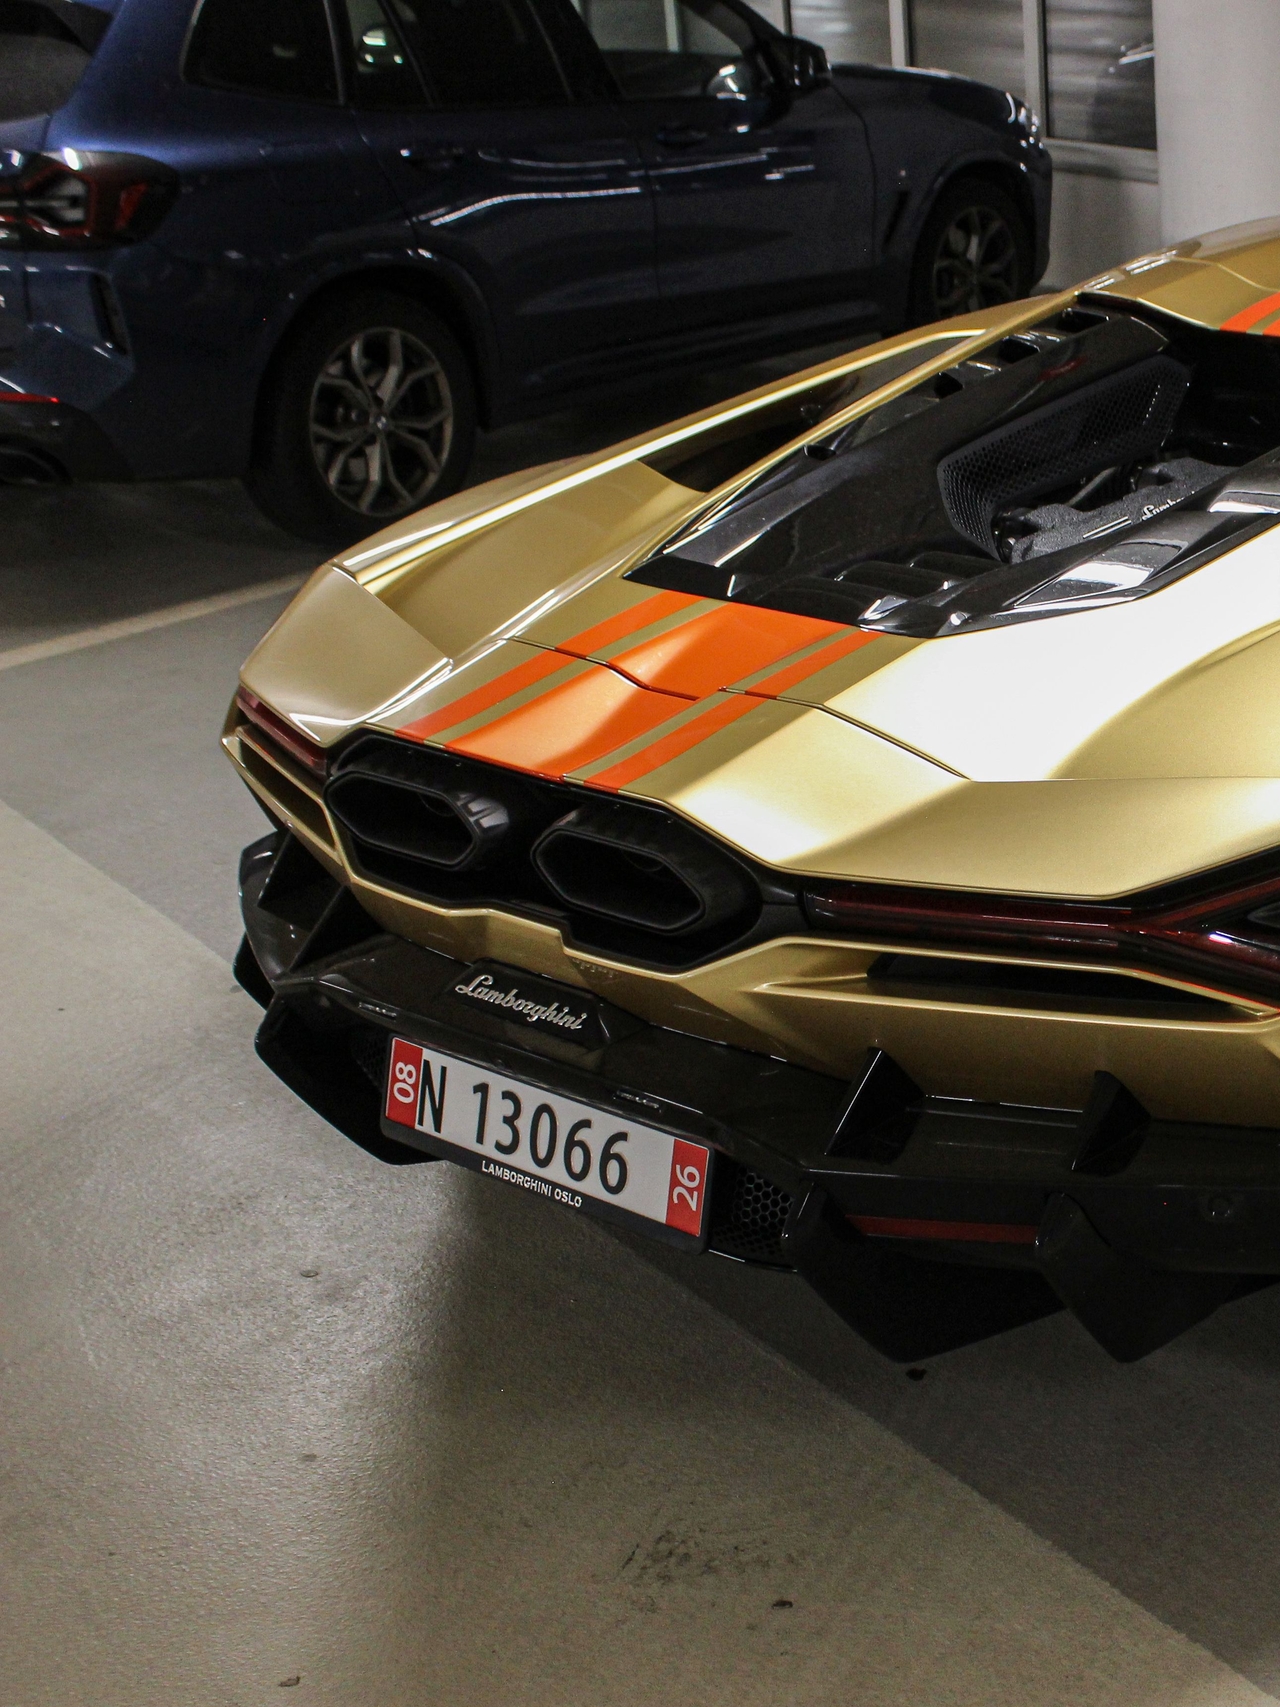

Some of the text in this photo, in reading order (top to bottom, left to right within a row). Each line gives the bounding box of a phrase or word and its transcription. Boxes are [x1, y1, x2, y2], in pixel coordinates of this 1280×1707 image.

[455, 974, 587, 1031] Lamborghini
[393, 1061, 417, 1104] 08
[417, 1058, 629, 1196] N 13066
[481, 1160, 583, 1209] LAMBORGHINI OSLO
[673, 1164, 700, 1212] 26
